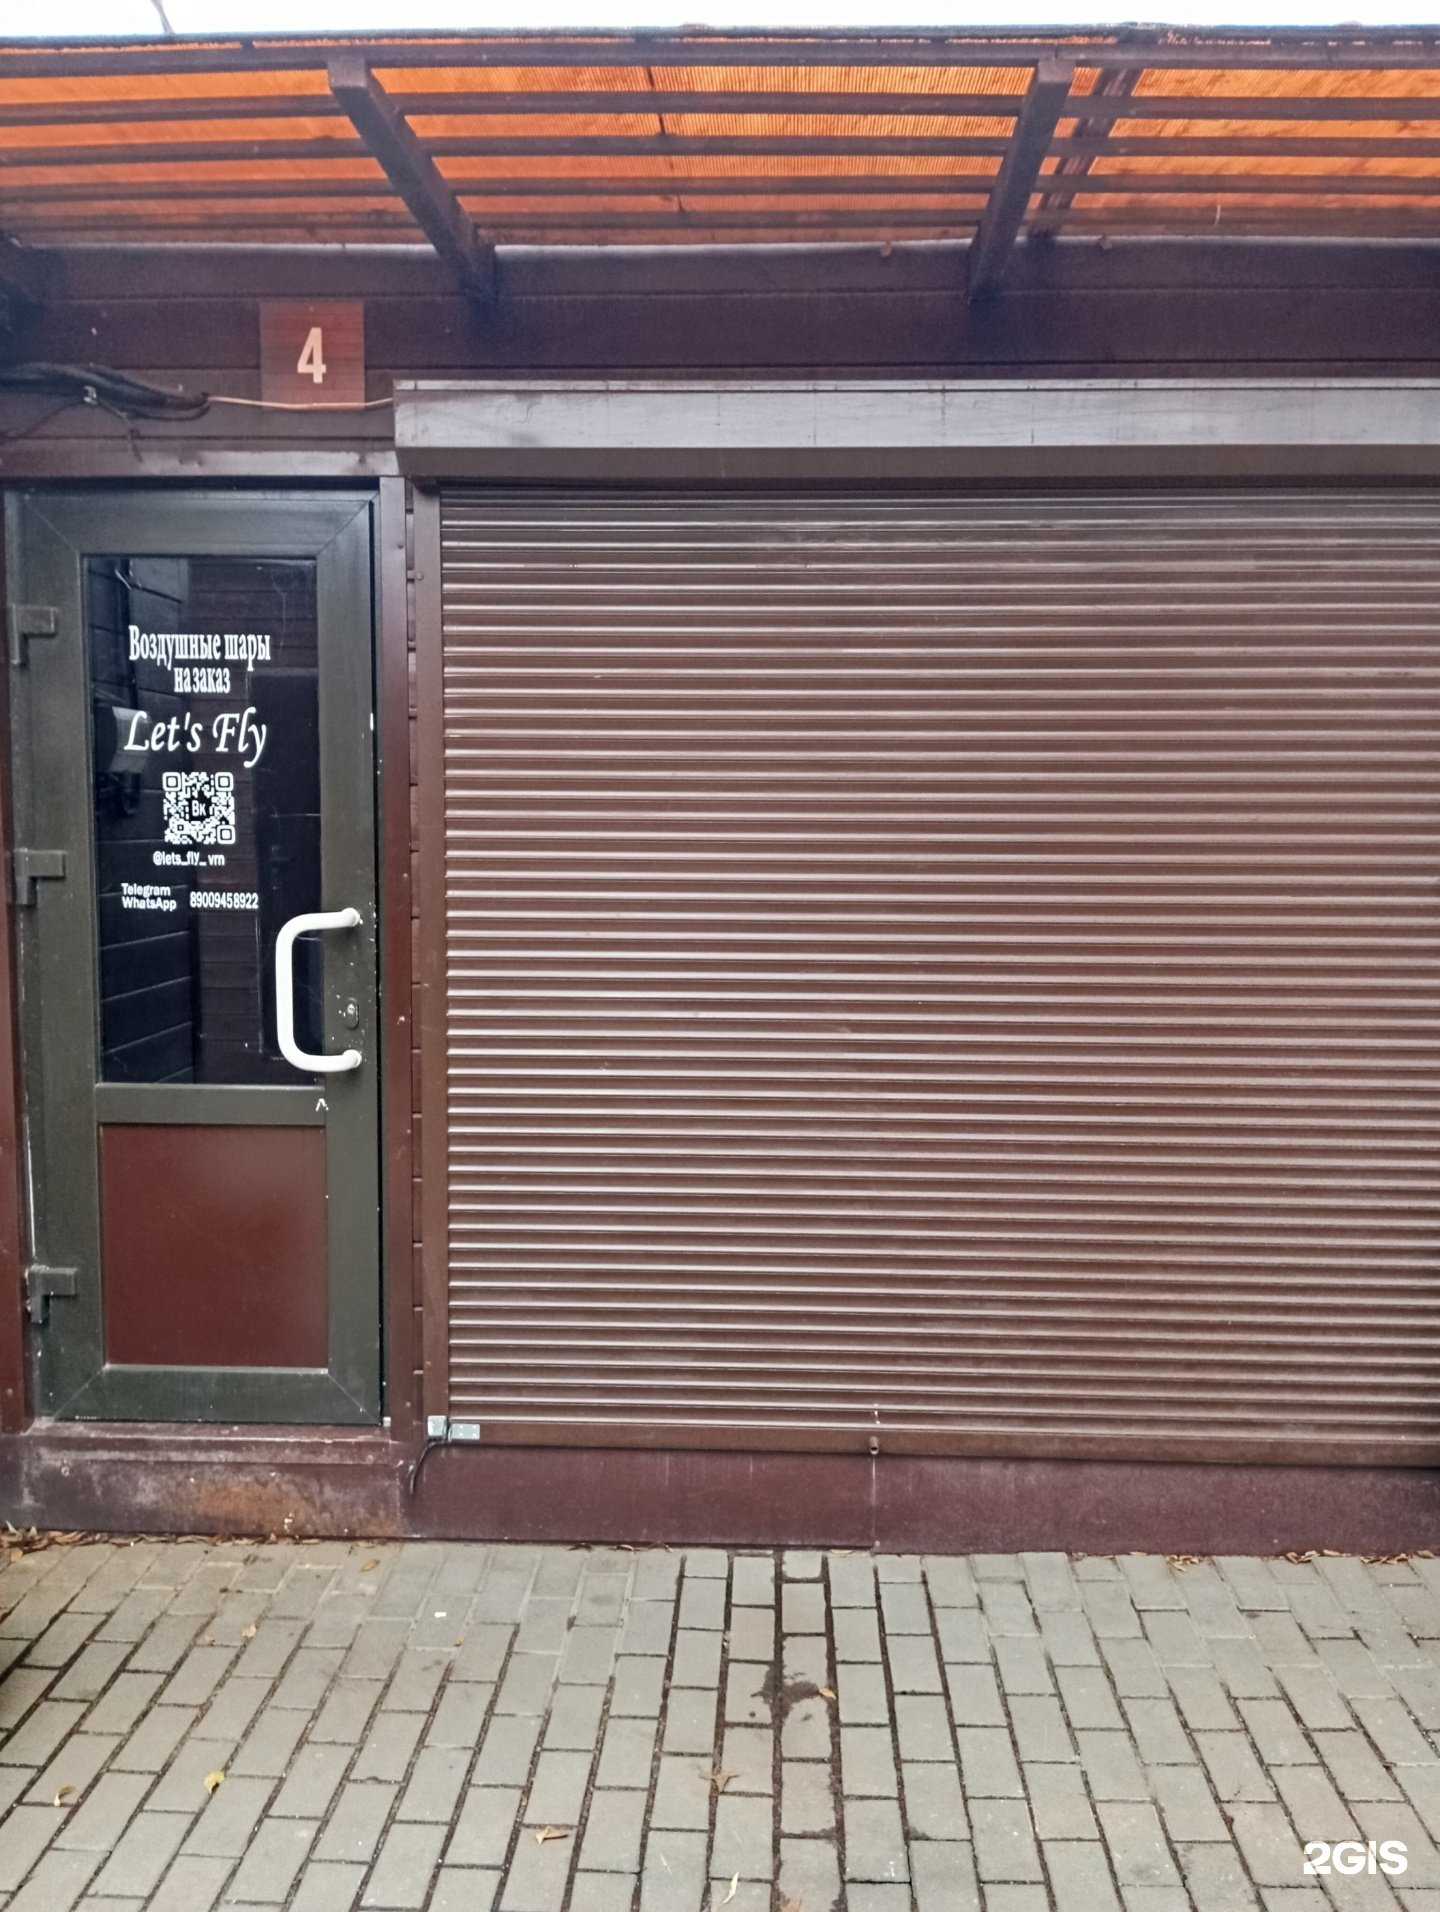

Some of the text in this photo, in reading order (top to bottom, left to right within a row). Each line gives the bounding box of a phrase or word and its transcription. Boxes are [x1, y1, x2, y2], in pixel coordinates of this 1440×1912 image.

[297, 327, 326, 384] 4
[129, 625, 271, 671] Воздушные шары
[174, 667, 230, 693] на заказ
[124, 707, 266, 768] Let's Fly
[121, 883, 171, 897] Telegram
[190, 891, 258, 909] 89009458922
[122, 897, 177, 911] WhatsApp
